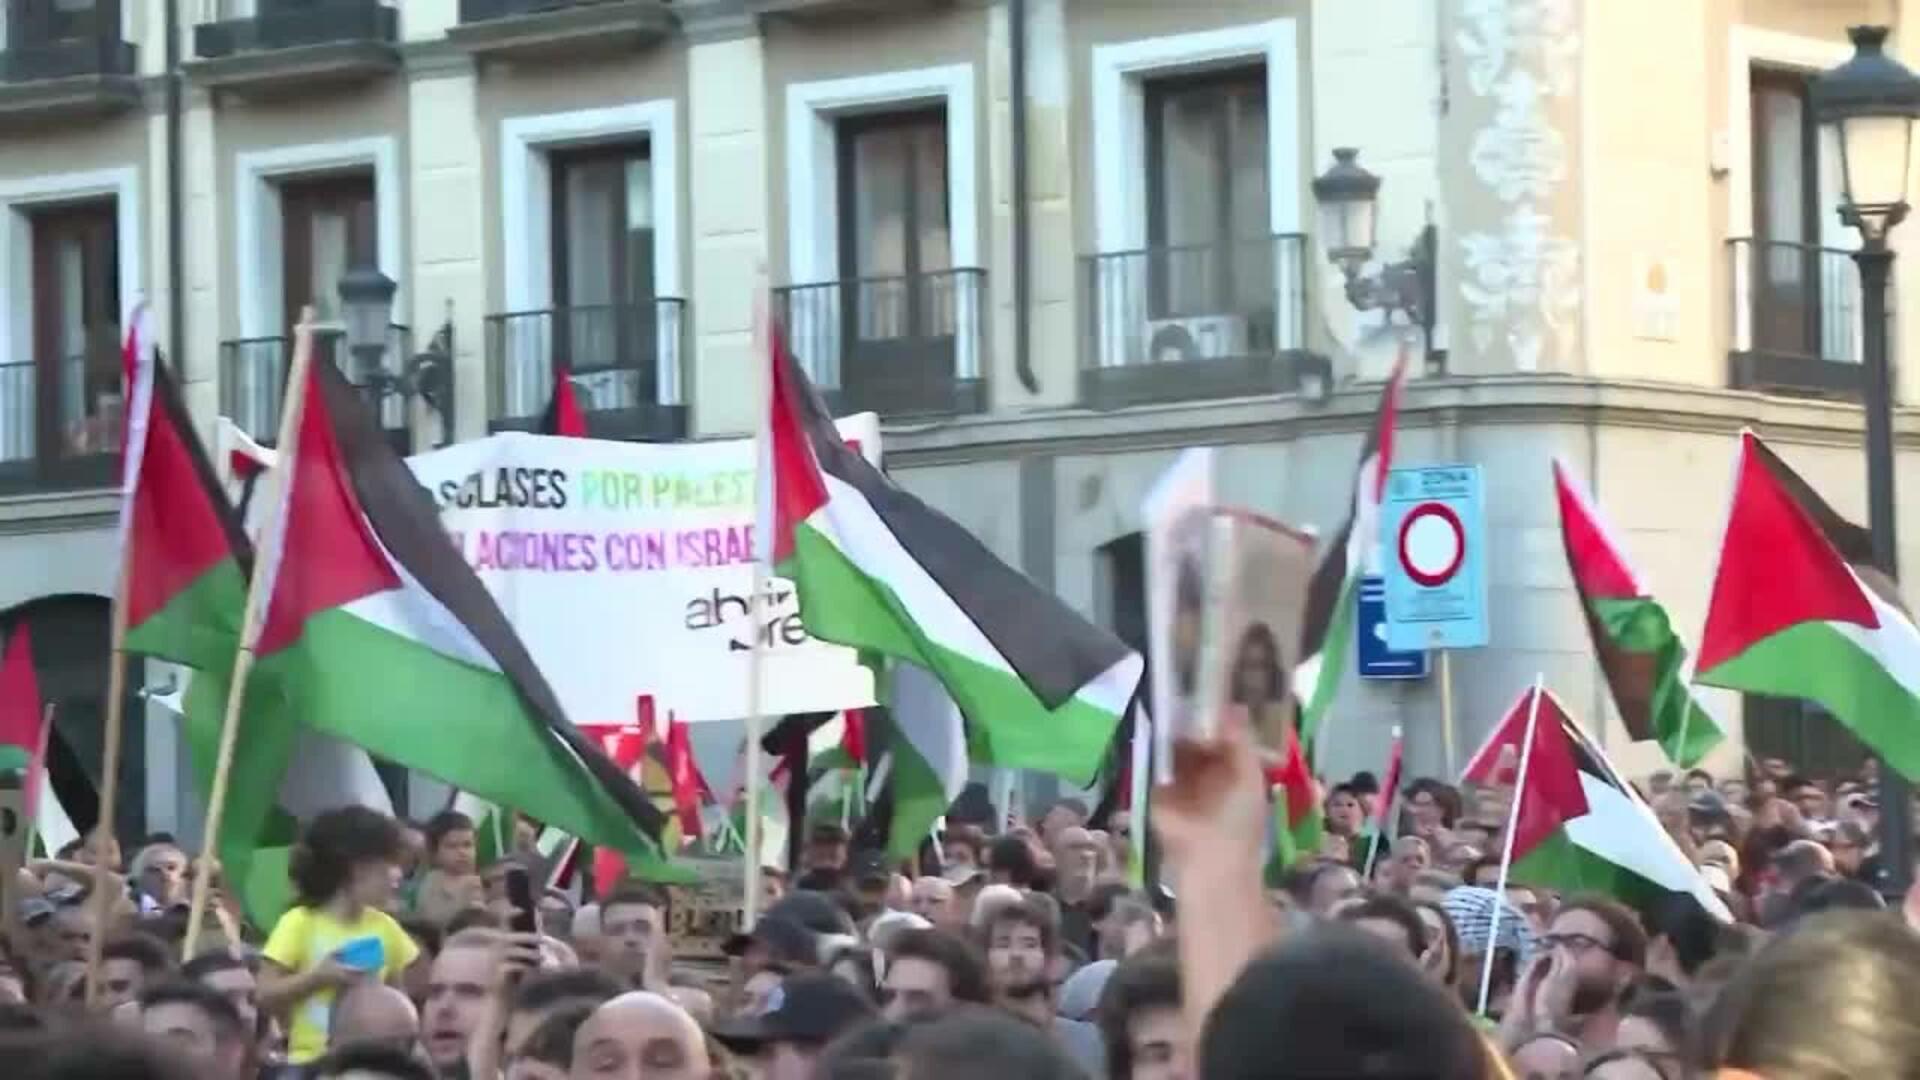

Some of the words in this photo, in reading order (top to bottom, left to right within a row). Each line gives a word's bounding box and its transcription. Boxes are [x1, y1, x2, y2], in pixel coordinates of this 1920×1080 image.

[582, 469, 643, 510] POR
[652, 467, 759, 507] PALEST
[604, 531, 666, 571] CON
[675, 523, 762, 568] ISRAE
